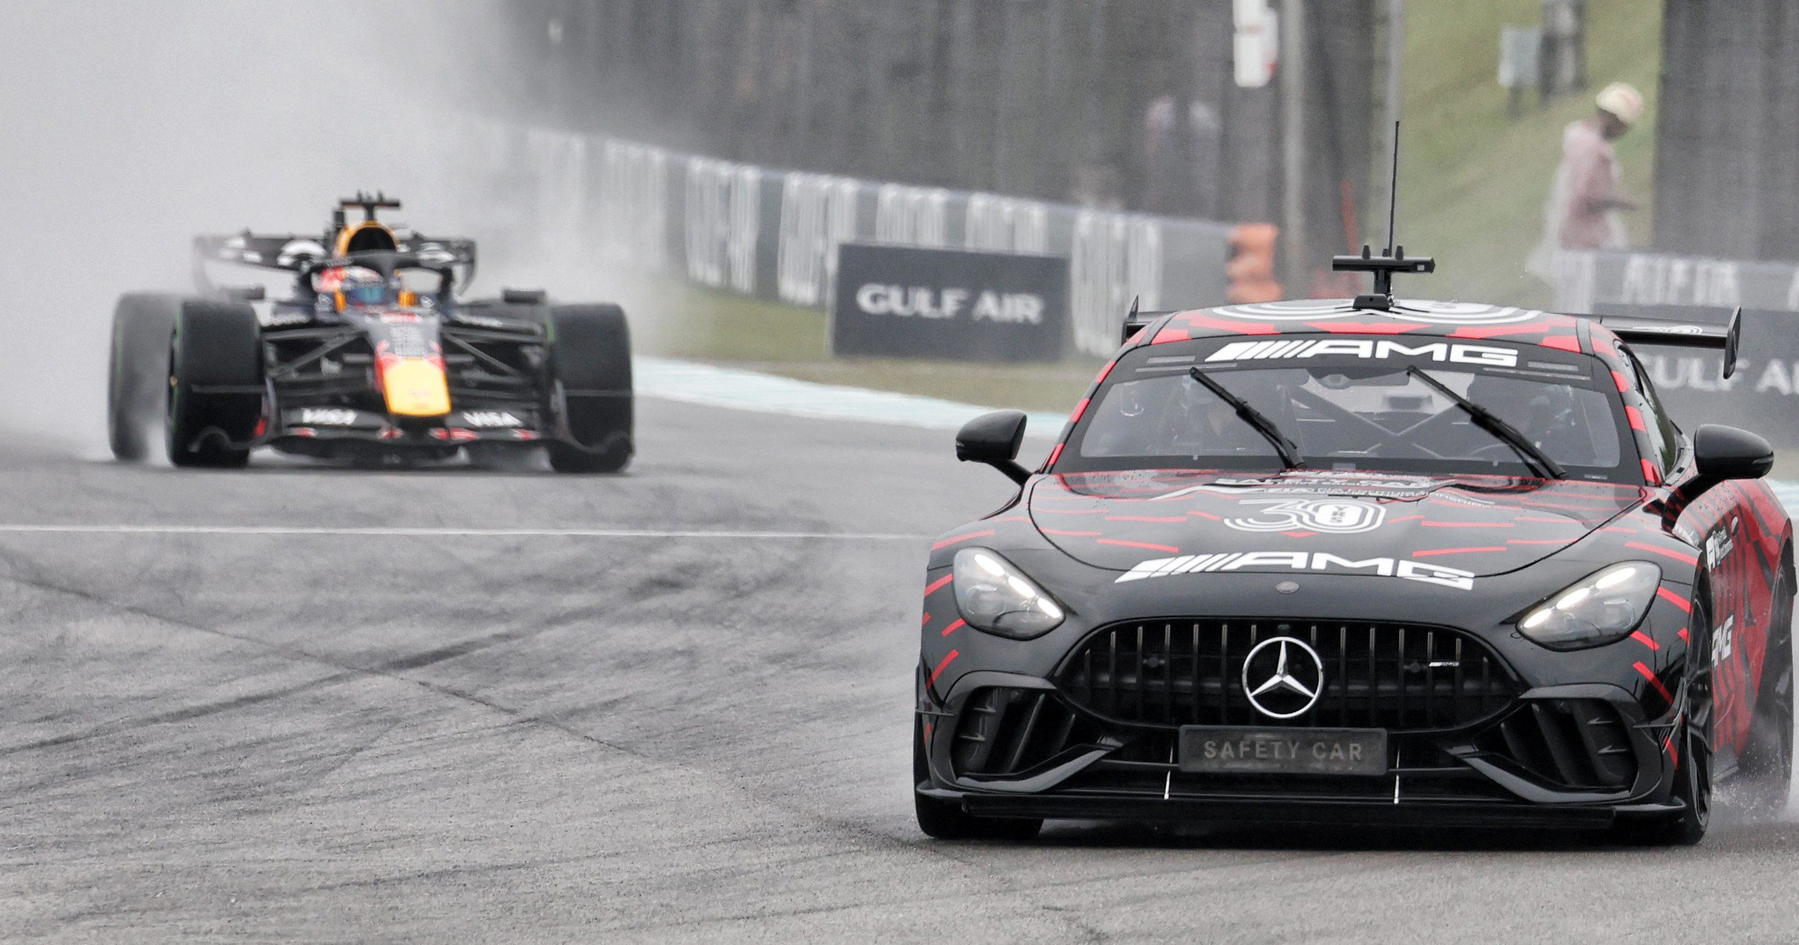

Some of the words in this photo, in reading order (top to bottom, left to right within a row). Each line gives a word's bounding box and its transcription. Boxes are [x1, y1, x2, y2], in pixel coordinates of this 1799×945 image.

[856, 283, 970, 319] GULF
[971, 289, 1045, 325] AIR
[1301, 340, 1519, 367] AMG
[1637, 353, 1750, 392] ULF
[1223, 499, 1387, 534] 30
[1221, 551, 1475, 591] AMG
[1204, 740, 1300, 760] SAFETY
[1311, 742, 1362, 761] CAR
